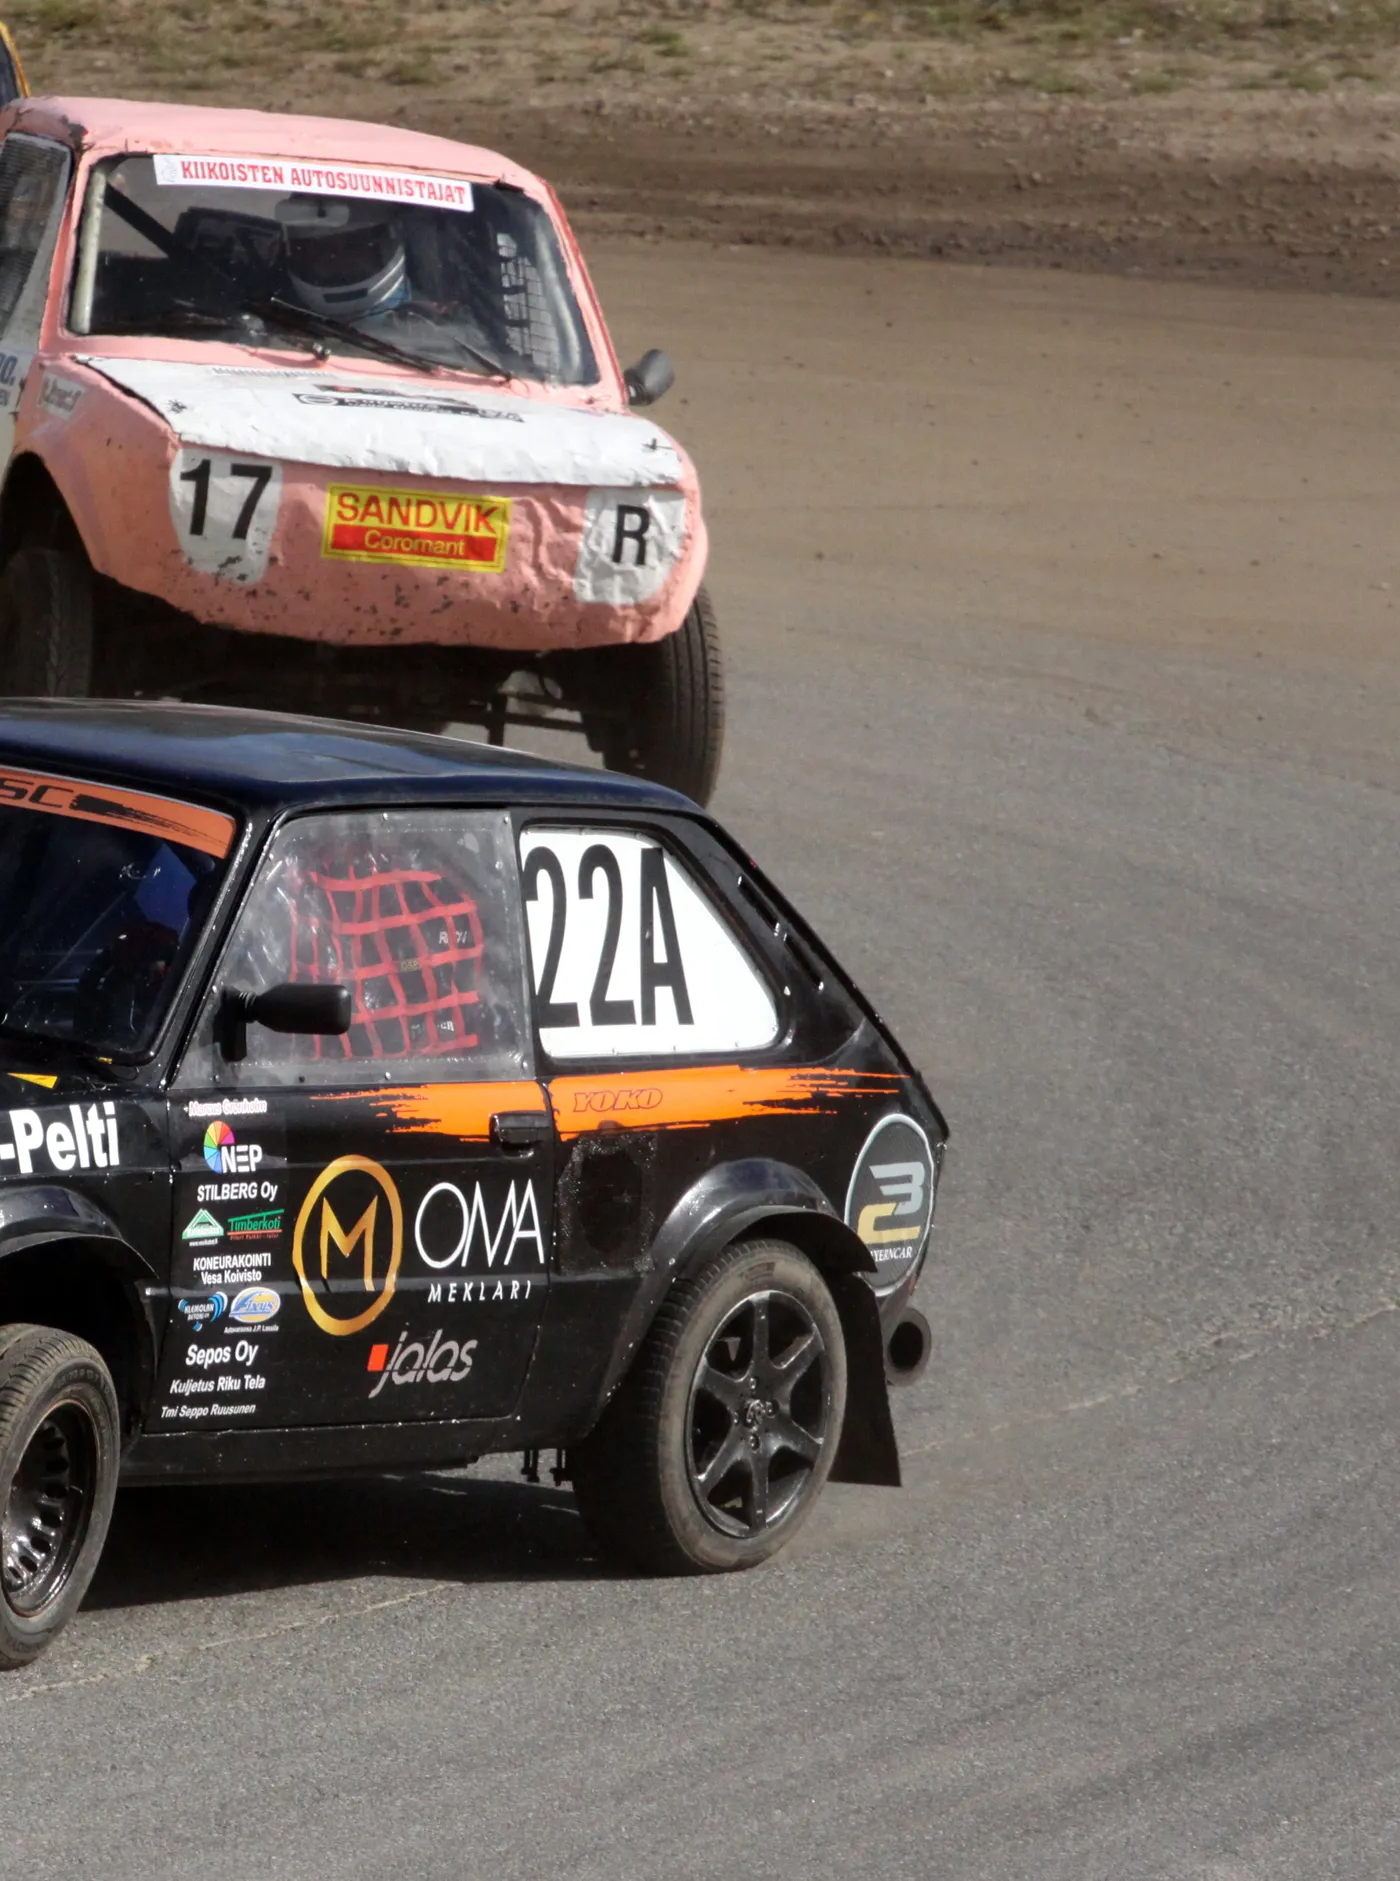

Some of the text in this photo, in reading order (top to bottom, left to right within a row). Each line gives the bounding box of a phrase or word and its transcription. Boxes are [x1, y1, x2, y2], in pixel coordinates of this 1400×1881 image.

[180, 160, 284, 184] KIIKOISTEN
[180, 459, 273, 540] 17
[335, 492, 499, 535] SANDVIK
[364, 529, 466, 557] Coromant
[612, 504, 651, 565] R
[522, 843, 695, 1029] 22A
[188, 1100, 222, 1117] Marcus
[221, 1144, 263, 1174] NEP
[197, 1181, 278, 1203] STILBERG Oy
[229, 1216, 281, 1232] Timberkoti
[414, 1179, 545, 1269] OMA
[193, 1253, 272, 1272] KONEURAKOINTI
[870, 1246, 913, 1263] YERNCAR
[201, 1268, 262, 1285] Vesa Koivisto
[427, 1281, 533, 1304] MEKLARI
[185, 1340, 259, 1369] Sepos Oy
[368, 1321, 478, 1399] jalas
[169, 1374, 266, 1396] Kuljetus Riku Tela
[179, 1405, 209, 1419] Seppo
[210, 1404, 257, 1416] Ruusunen
